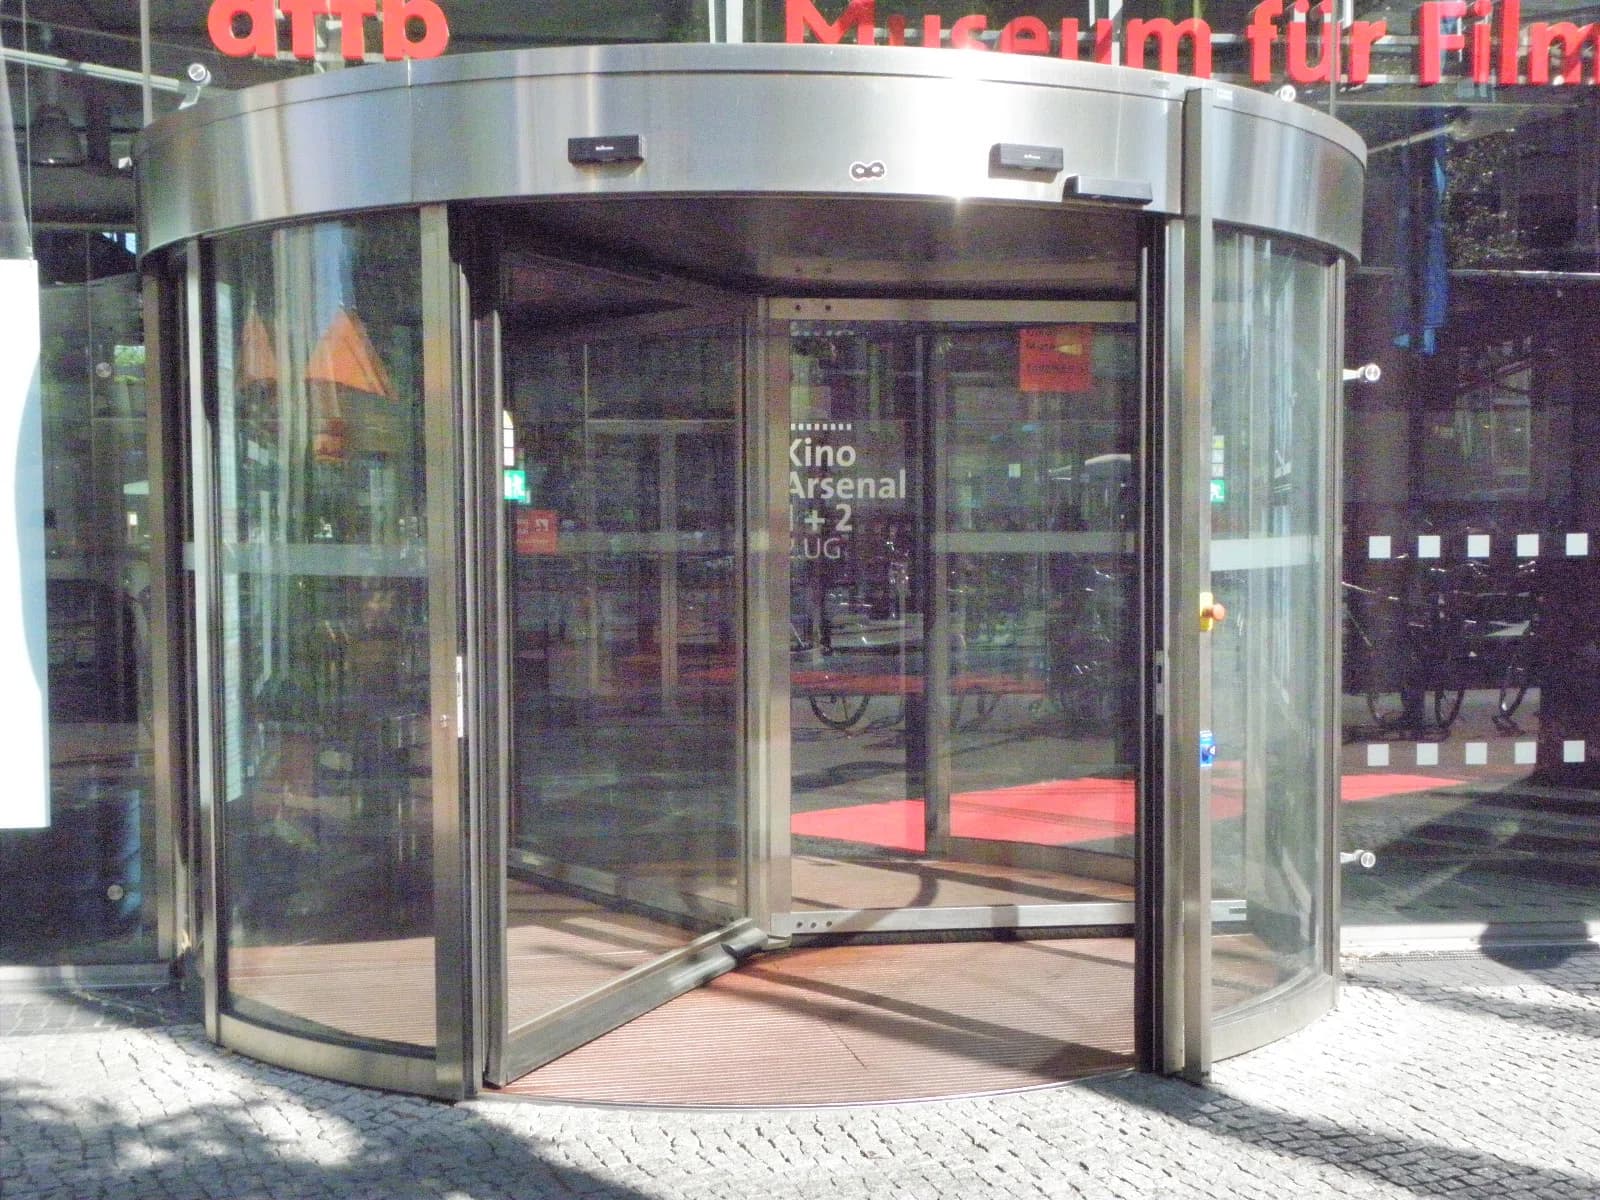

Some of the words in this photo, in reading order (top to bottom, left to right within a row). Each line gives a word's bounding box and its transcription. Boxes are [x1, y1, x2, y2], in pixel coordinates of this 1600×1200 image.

[1247, 0, 1387, 84] für
[1419, 0, 1600, 85] Film
[790, 437, 857, 467] Kino
[790, 468, 906, 499] Arsenal
[835, 503, 853, 532] 2
